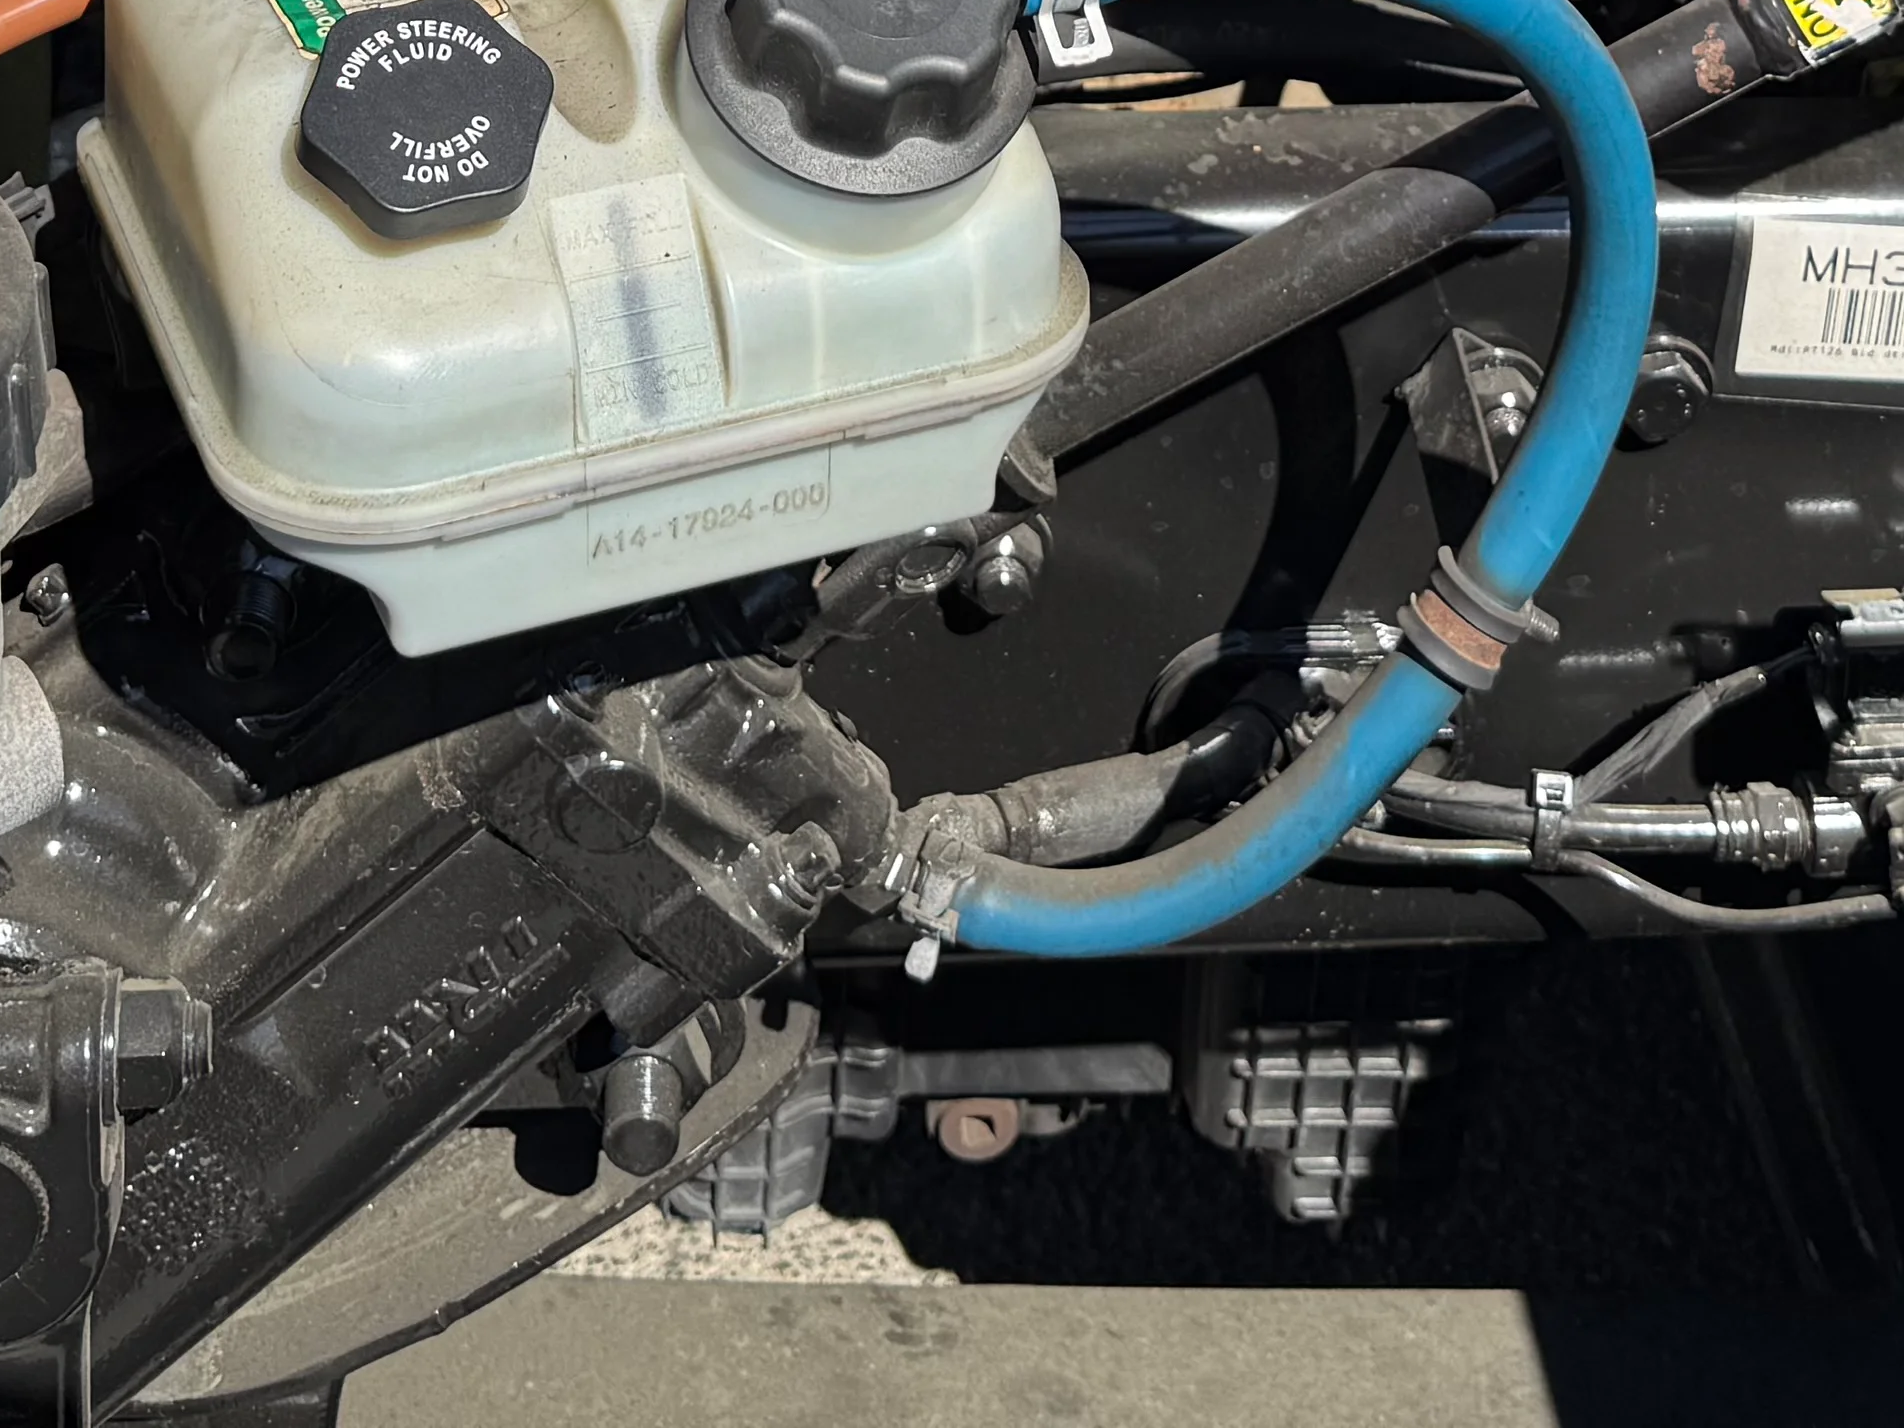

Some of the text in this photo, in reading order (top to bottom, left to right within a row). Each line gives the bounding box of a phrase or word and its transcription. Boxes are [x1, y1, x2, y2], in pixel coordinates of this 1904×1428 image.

[336, 19, 503, 91] POWER STEERING
[377, 41, 454, 73] FLUID
[389, 114, 492, 163] OVERFILL
[402, 150, 491, 184] DO NOT
[591, 481, 826, 560] A14-17924-000
